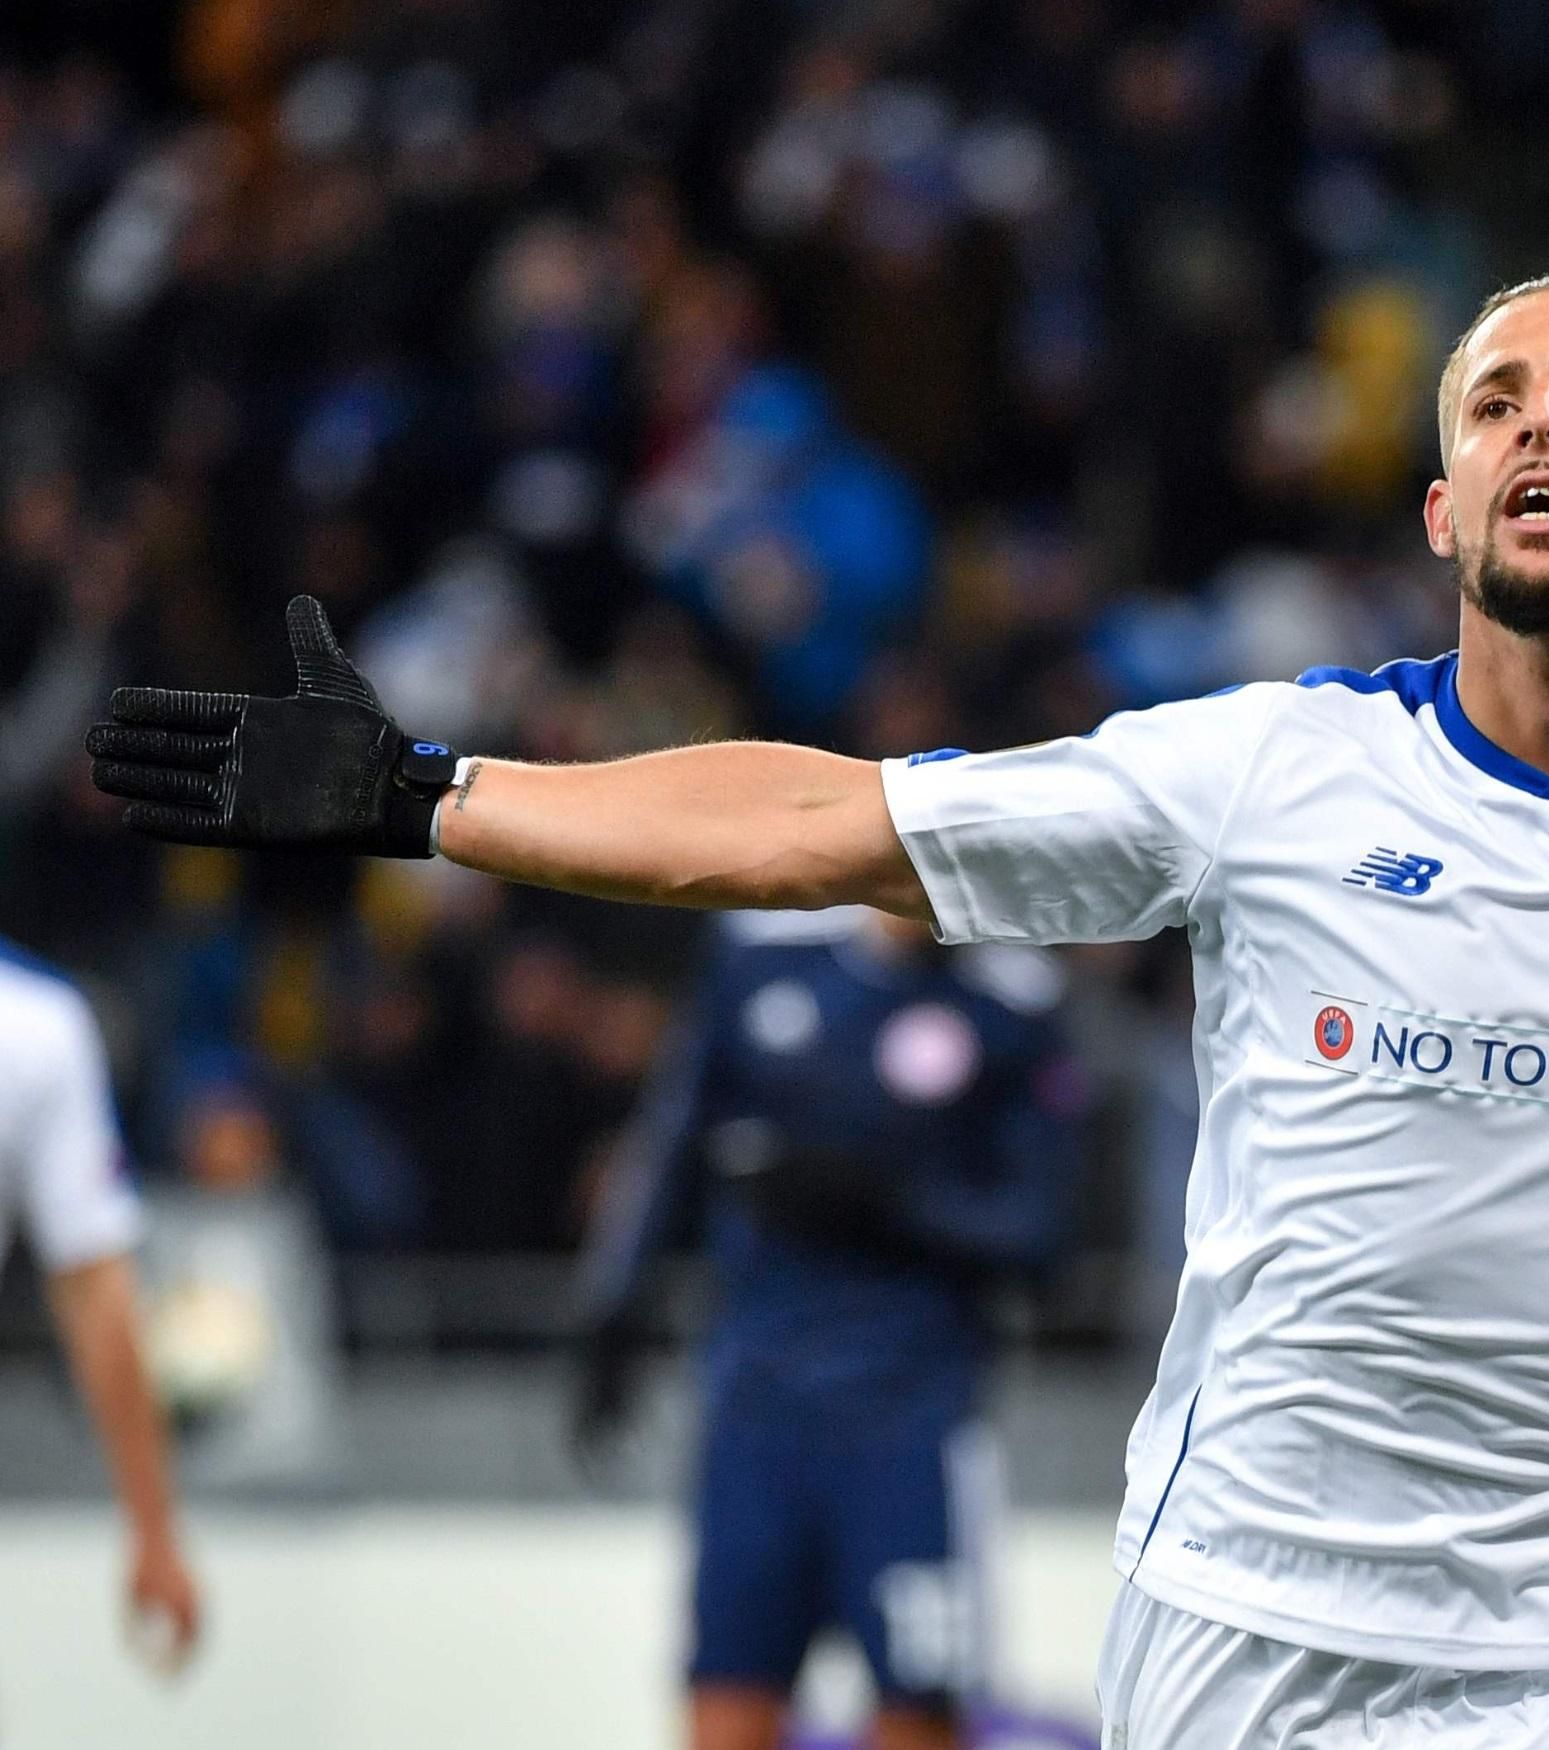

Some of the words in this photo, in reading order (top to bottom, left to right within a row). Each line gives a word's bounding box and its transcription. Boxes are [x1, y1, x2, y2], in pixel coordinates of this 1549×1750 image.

[1322, 1009, 1346, 1024] UEFA
[1371, 1021, 1453, 1074] NO
[1472, 1038, 1547, 1087] TO
